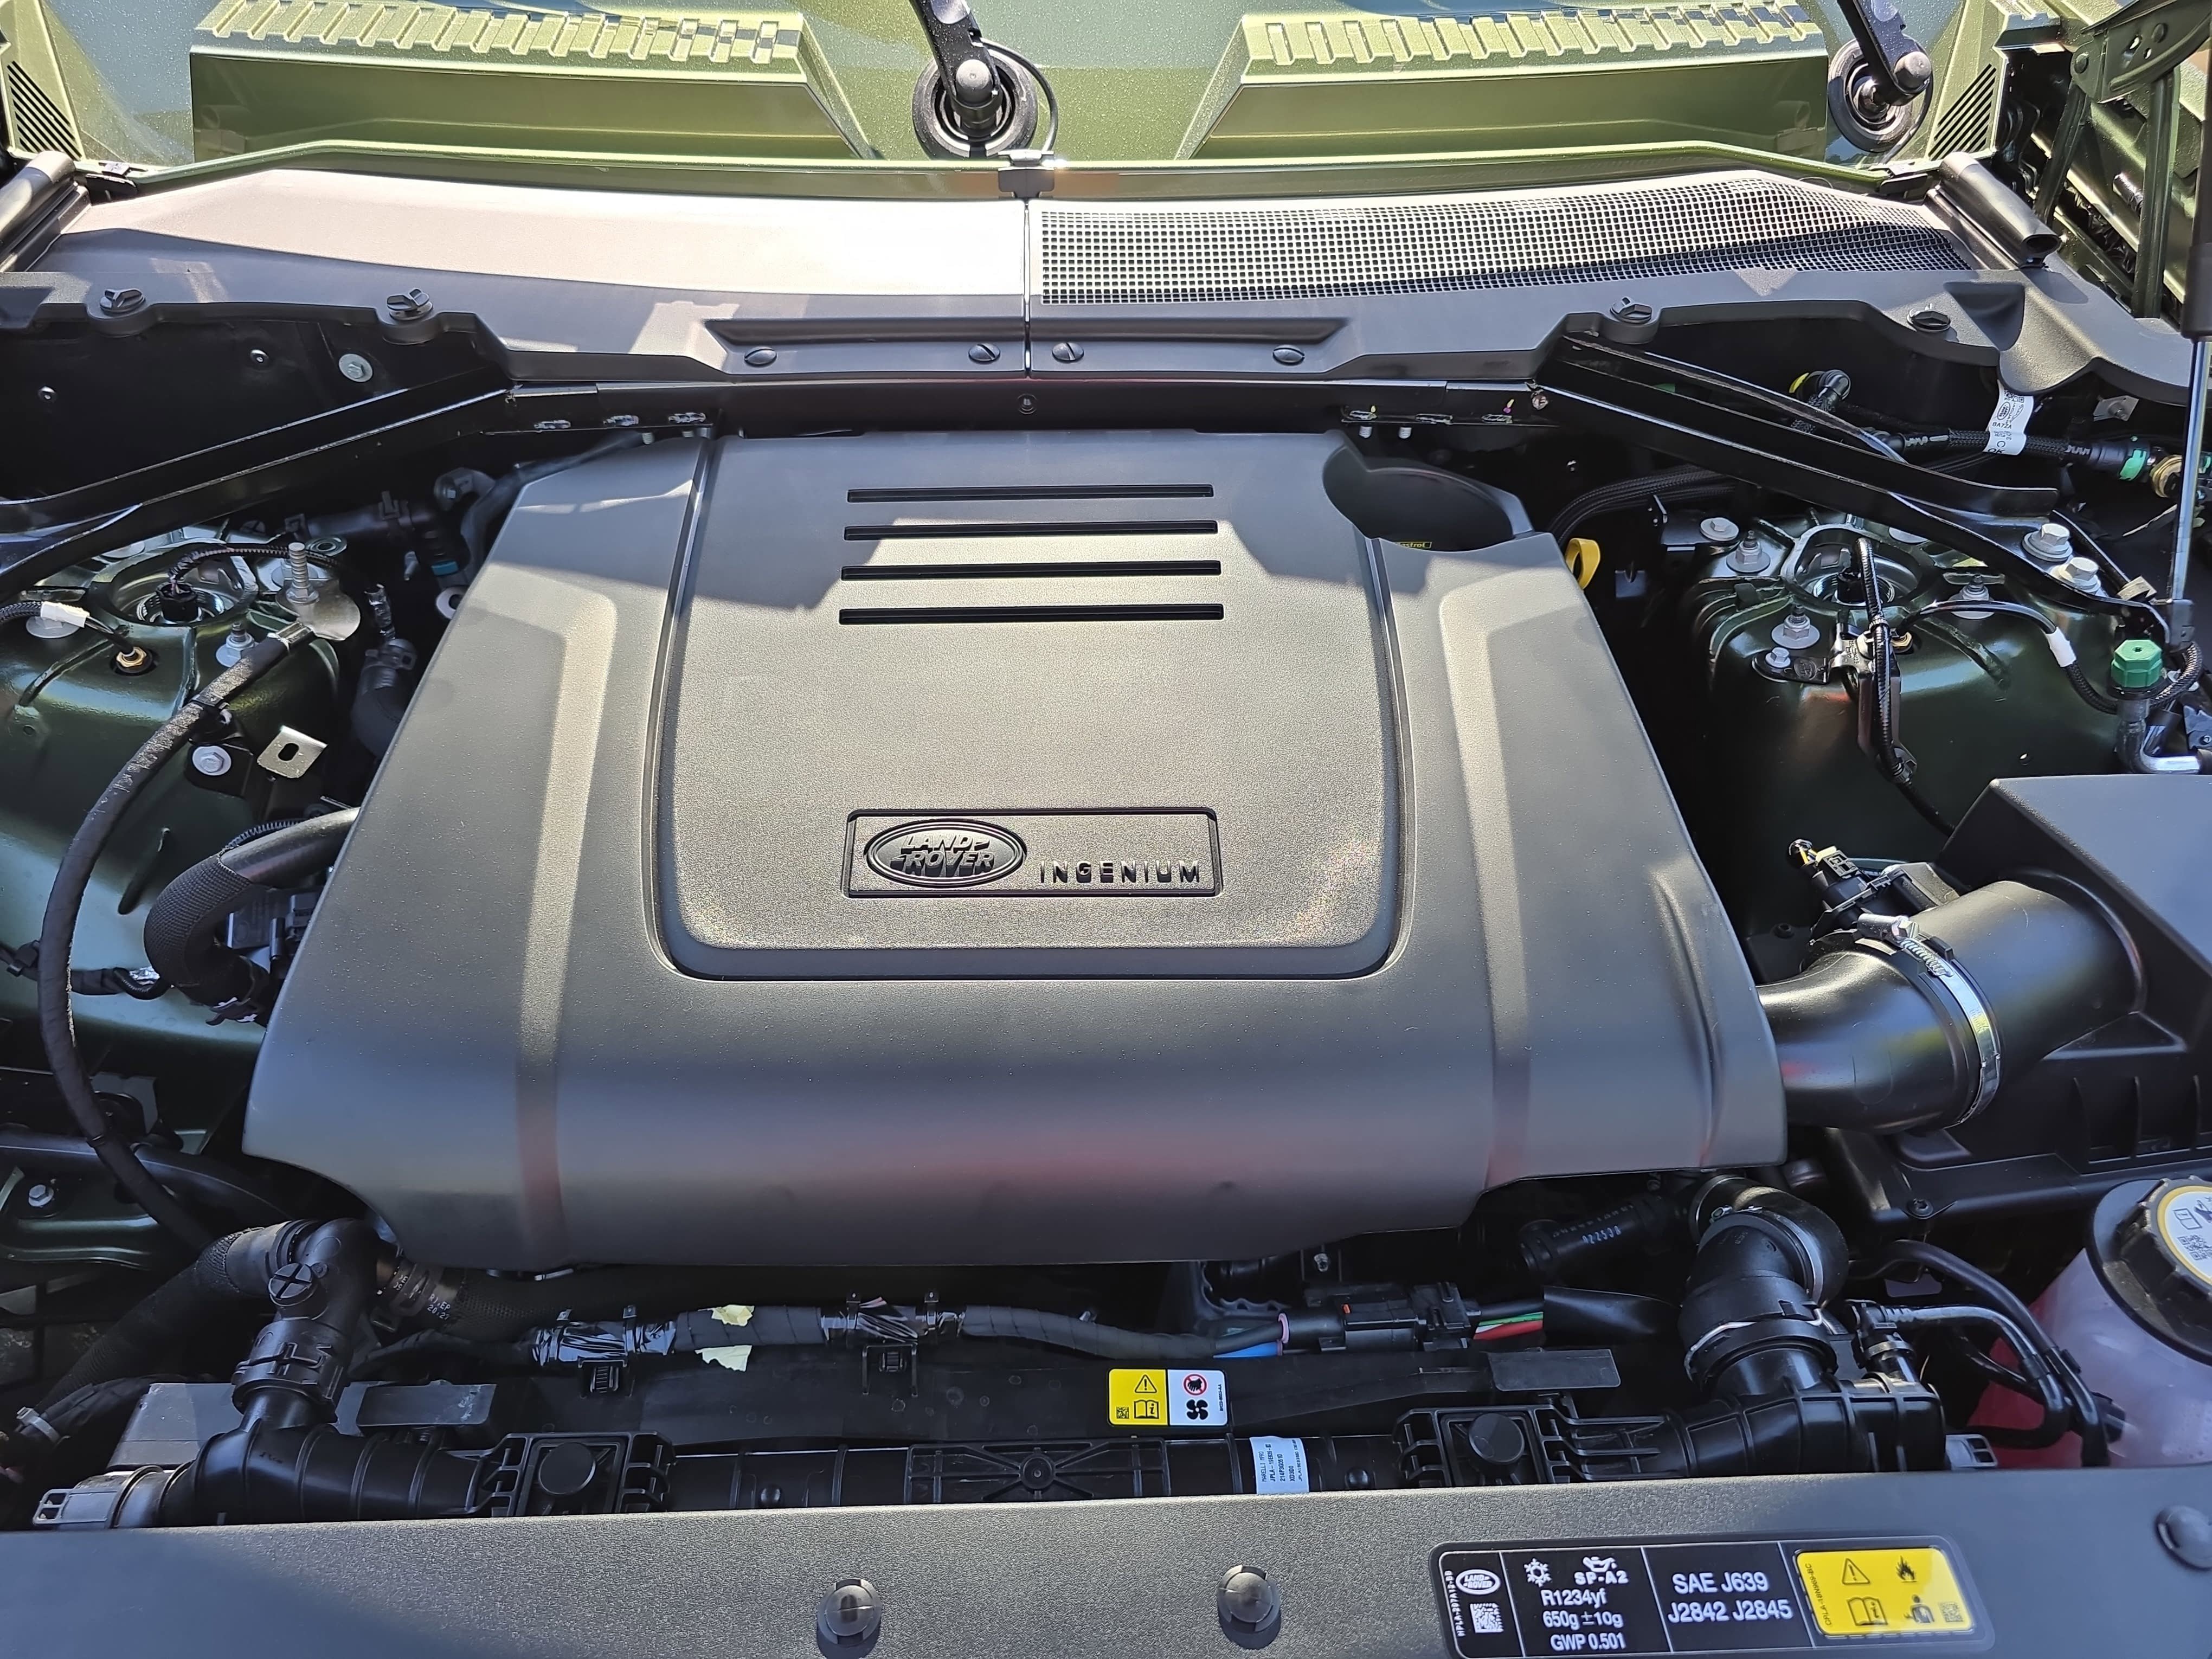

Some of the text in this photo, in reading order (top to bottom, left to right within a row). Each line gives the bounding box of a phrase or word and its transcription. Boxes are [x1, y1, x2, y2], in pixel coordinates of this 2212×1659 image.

[901, 834, 975, 852] LAND
[902, 851, 996, 877] ROVER
[1040, 860, 1199, 883] INGENIUM
[1467, 1580, 1493, 1589] ROVER
[1574, 1571, 1629, 1585] SP-A2
[1672, 1572, 1769, 1594] SAE J639
[1541, 1588, 1607, 1609] R1234yf
[1543, 1611, 1624, 1630] 650g ±10g
[1668, 1599, 1793, 1623] J2842 J2845
[1550, 1632, 1626, 1651] GWP 0.501
